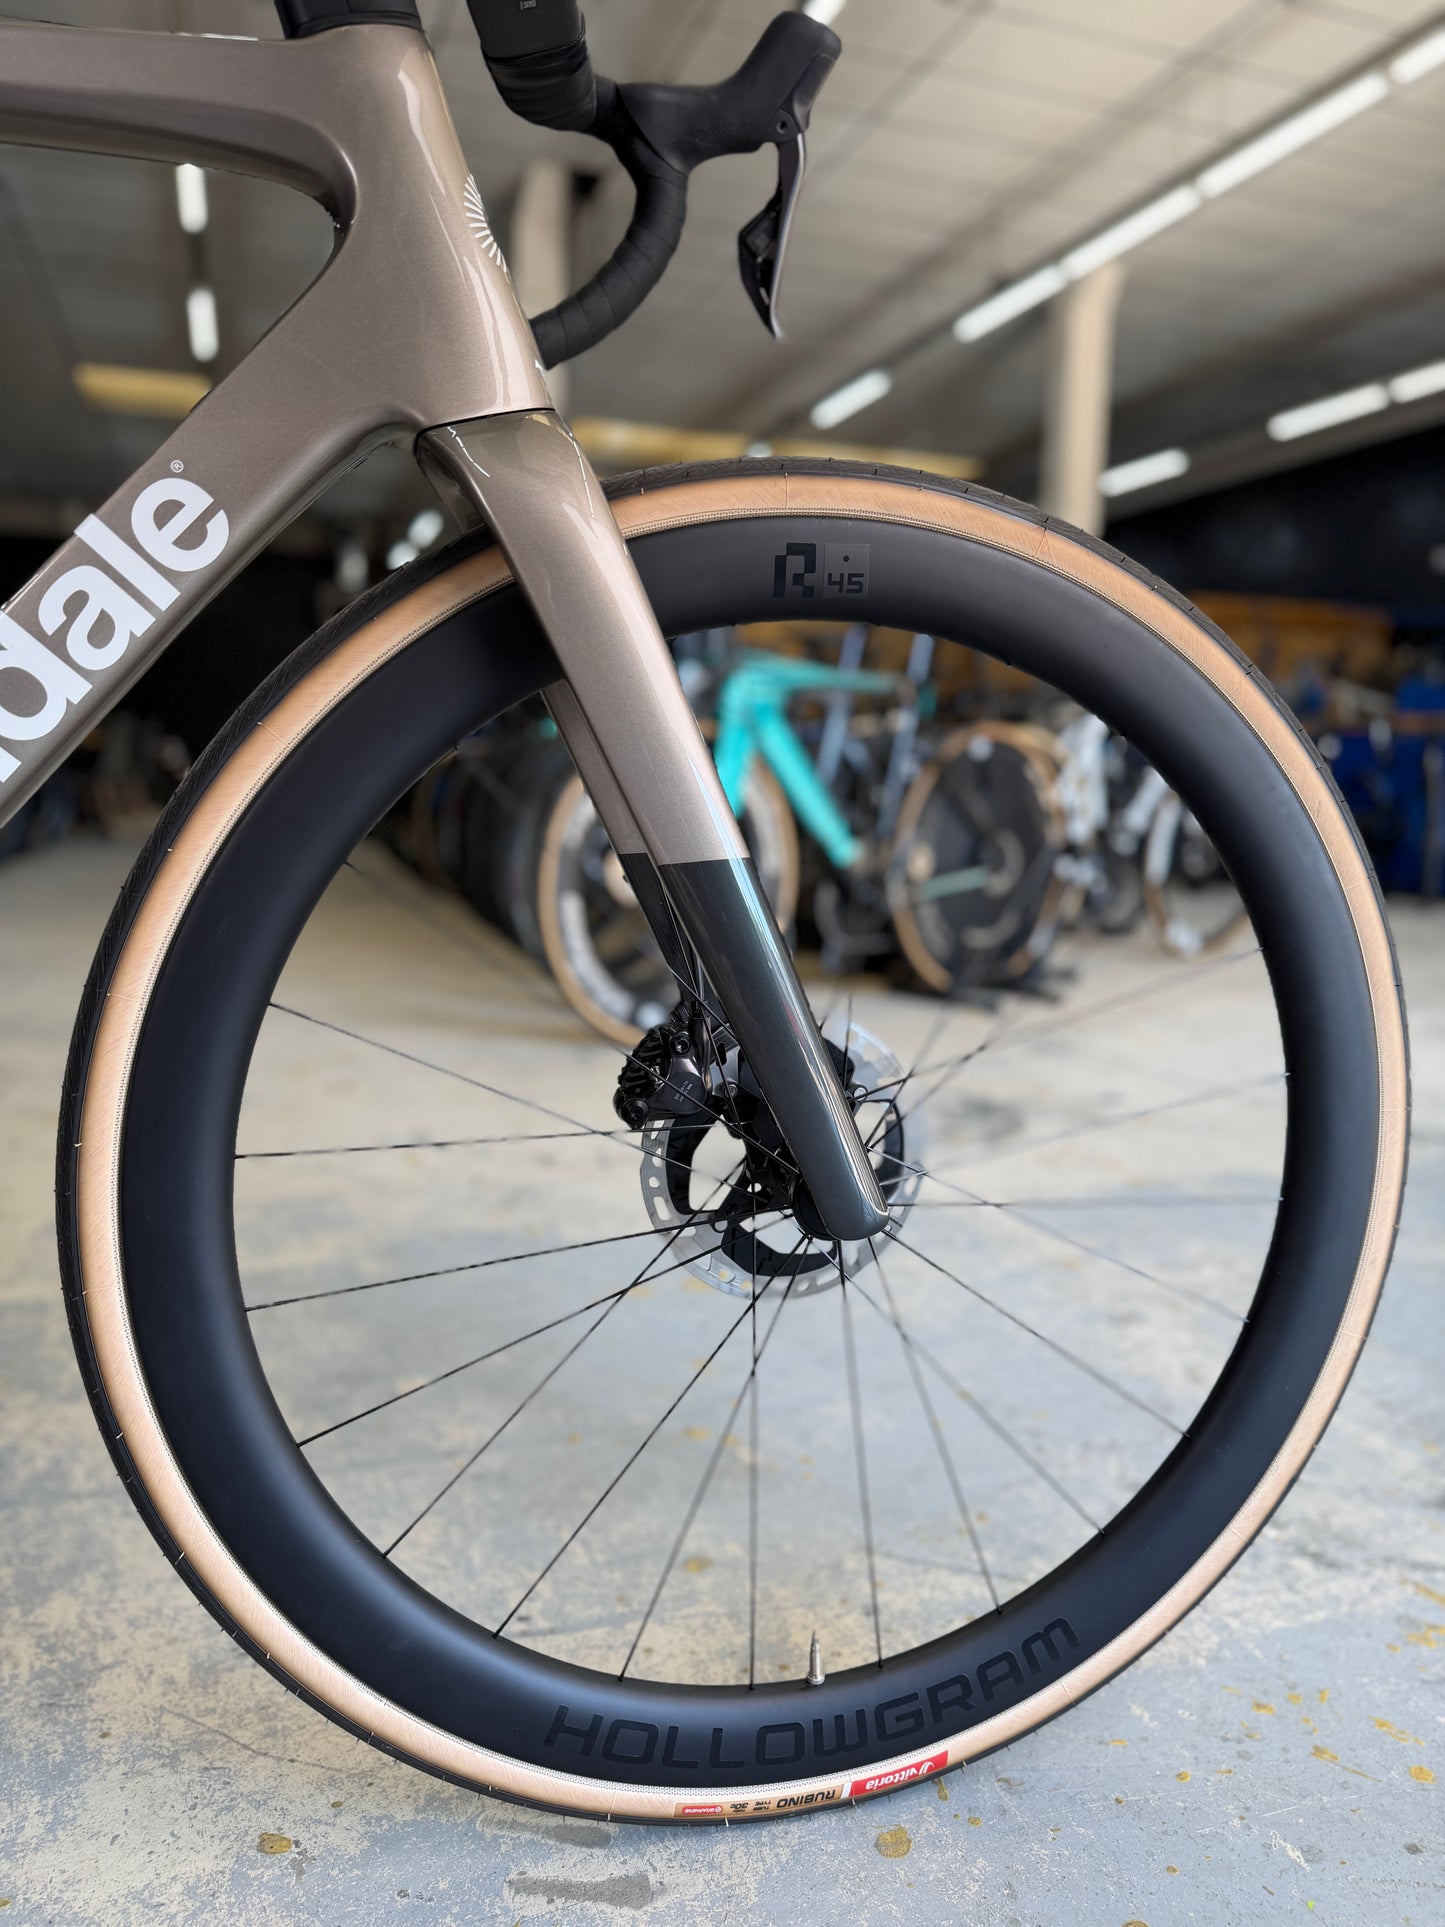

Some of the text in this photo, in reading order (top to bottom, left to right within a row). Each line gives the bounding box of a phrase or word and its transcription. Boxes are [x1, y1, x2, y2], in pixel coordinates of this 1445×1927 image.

[827, 572, 865, 594] 45
[0, 477, 230, 783] dale
[543, 1616, 1081, 1770] HOLLOWGRAM
[865, 1765, 918, 1790] vittoria
[684, 1806, 715, 1814] GRAPHENE
[776, 1788, 837, 1809] RUBINO
